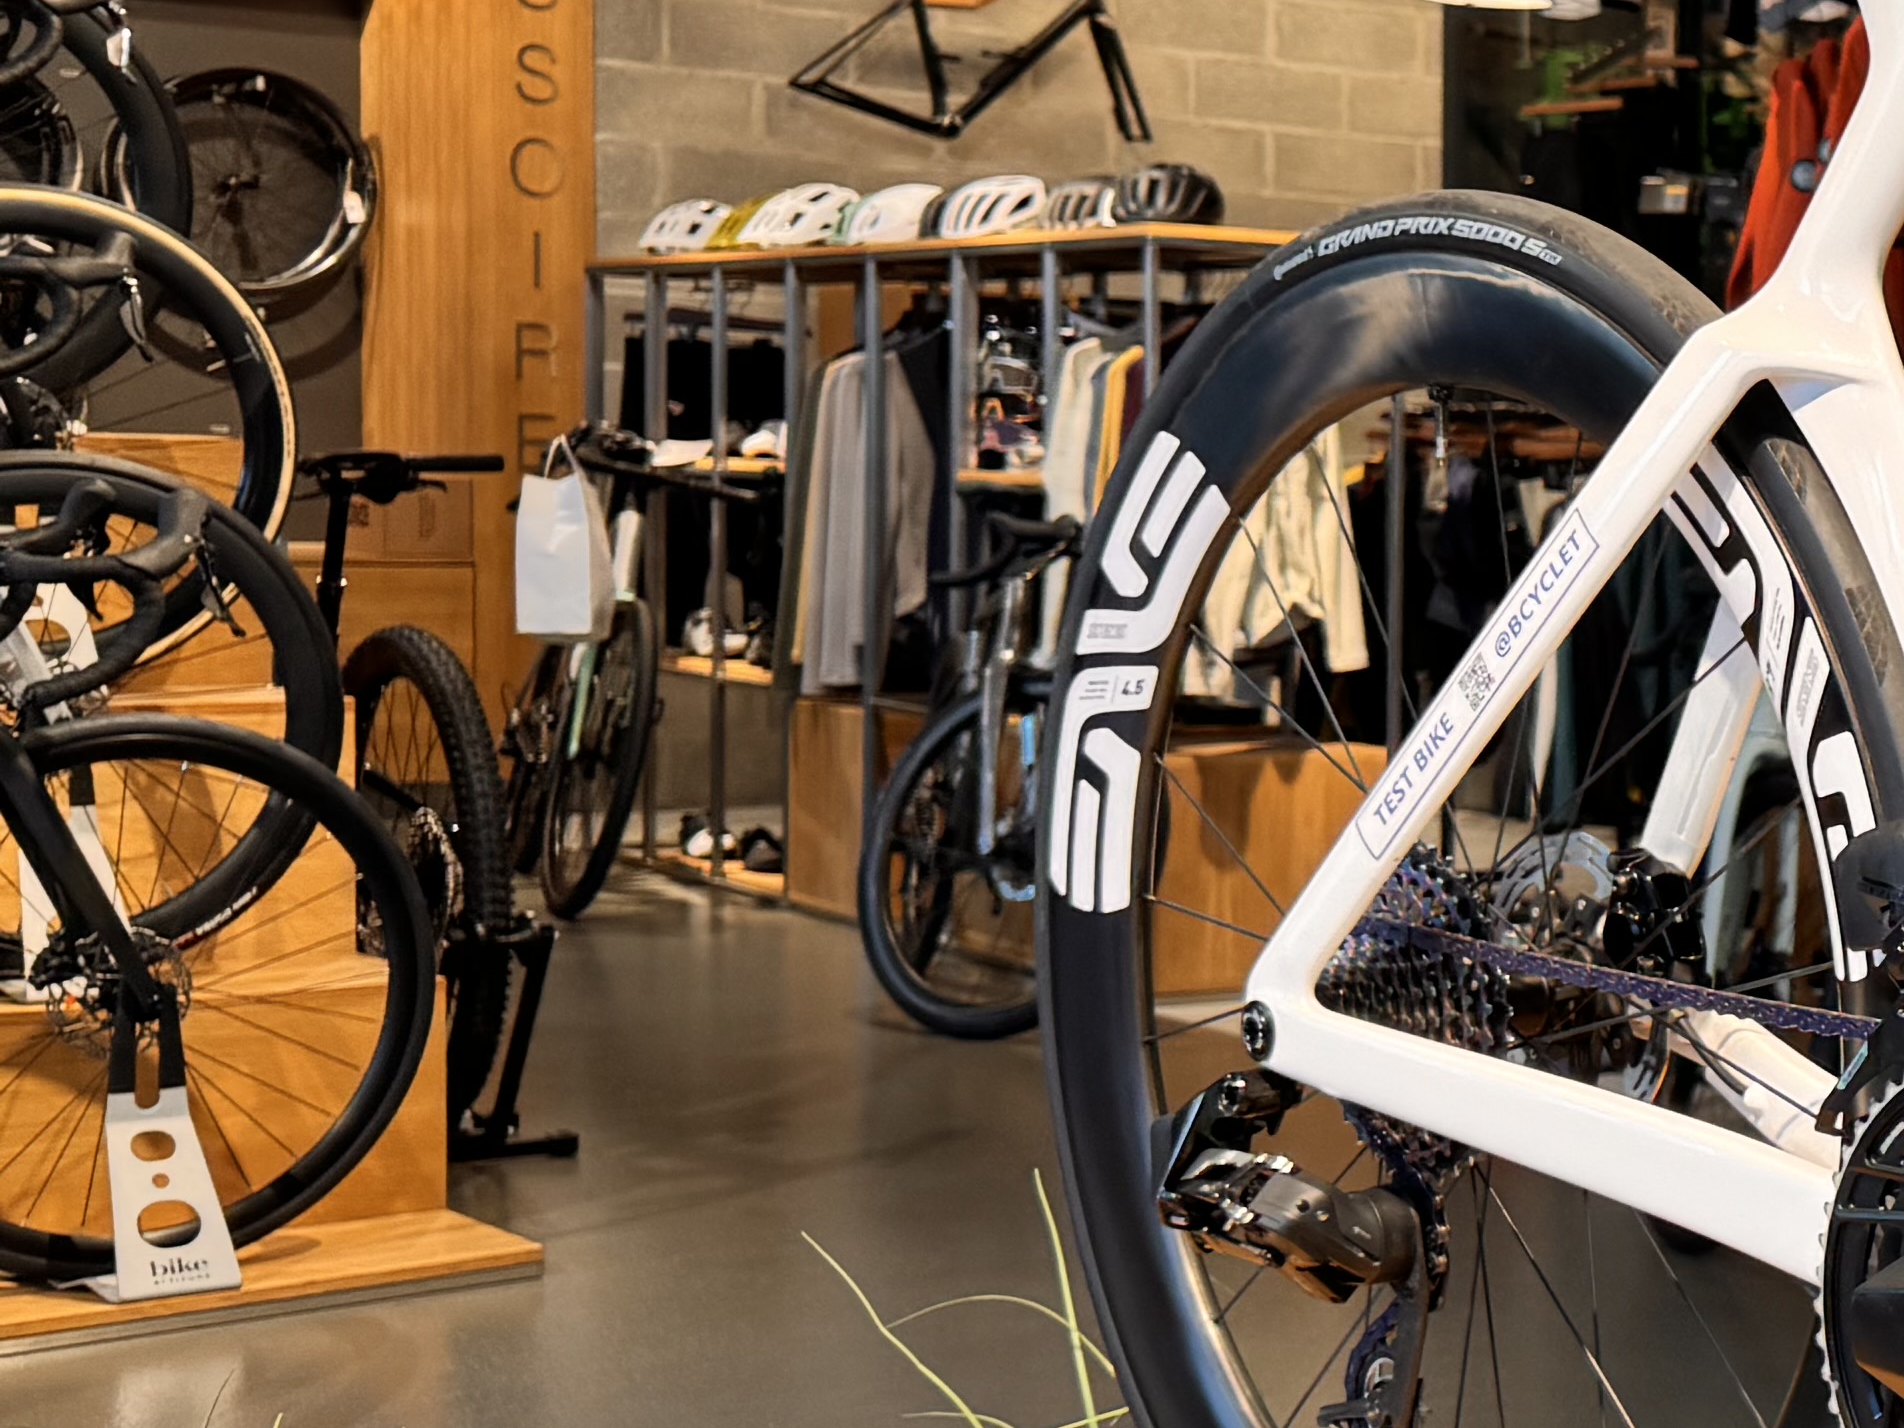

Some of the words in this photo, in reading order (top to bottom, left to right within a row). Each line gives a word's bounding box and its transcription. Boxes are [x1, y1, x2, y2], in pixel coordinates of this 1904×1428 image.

[1318, 220, 1395, 257] GRAND
[1394, 217, 1454, 235] PRIX
[1451, 219, 1526, 251] 5000
[1495, 529, 1581, 657] @BCYCLET
[1373, 769, 1413, 826] TEST
[1414, 712, 1454, 772] BIKE
